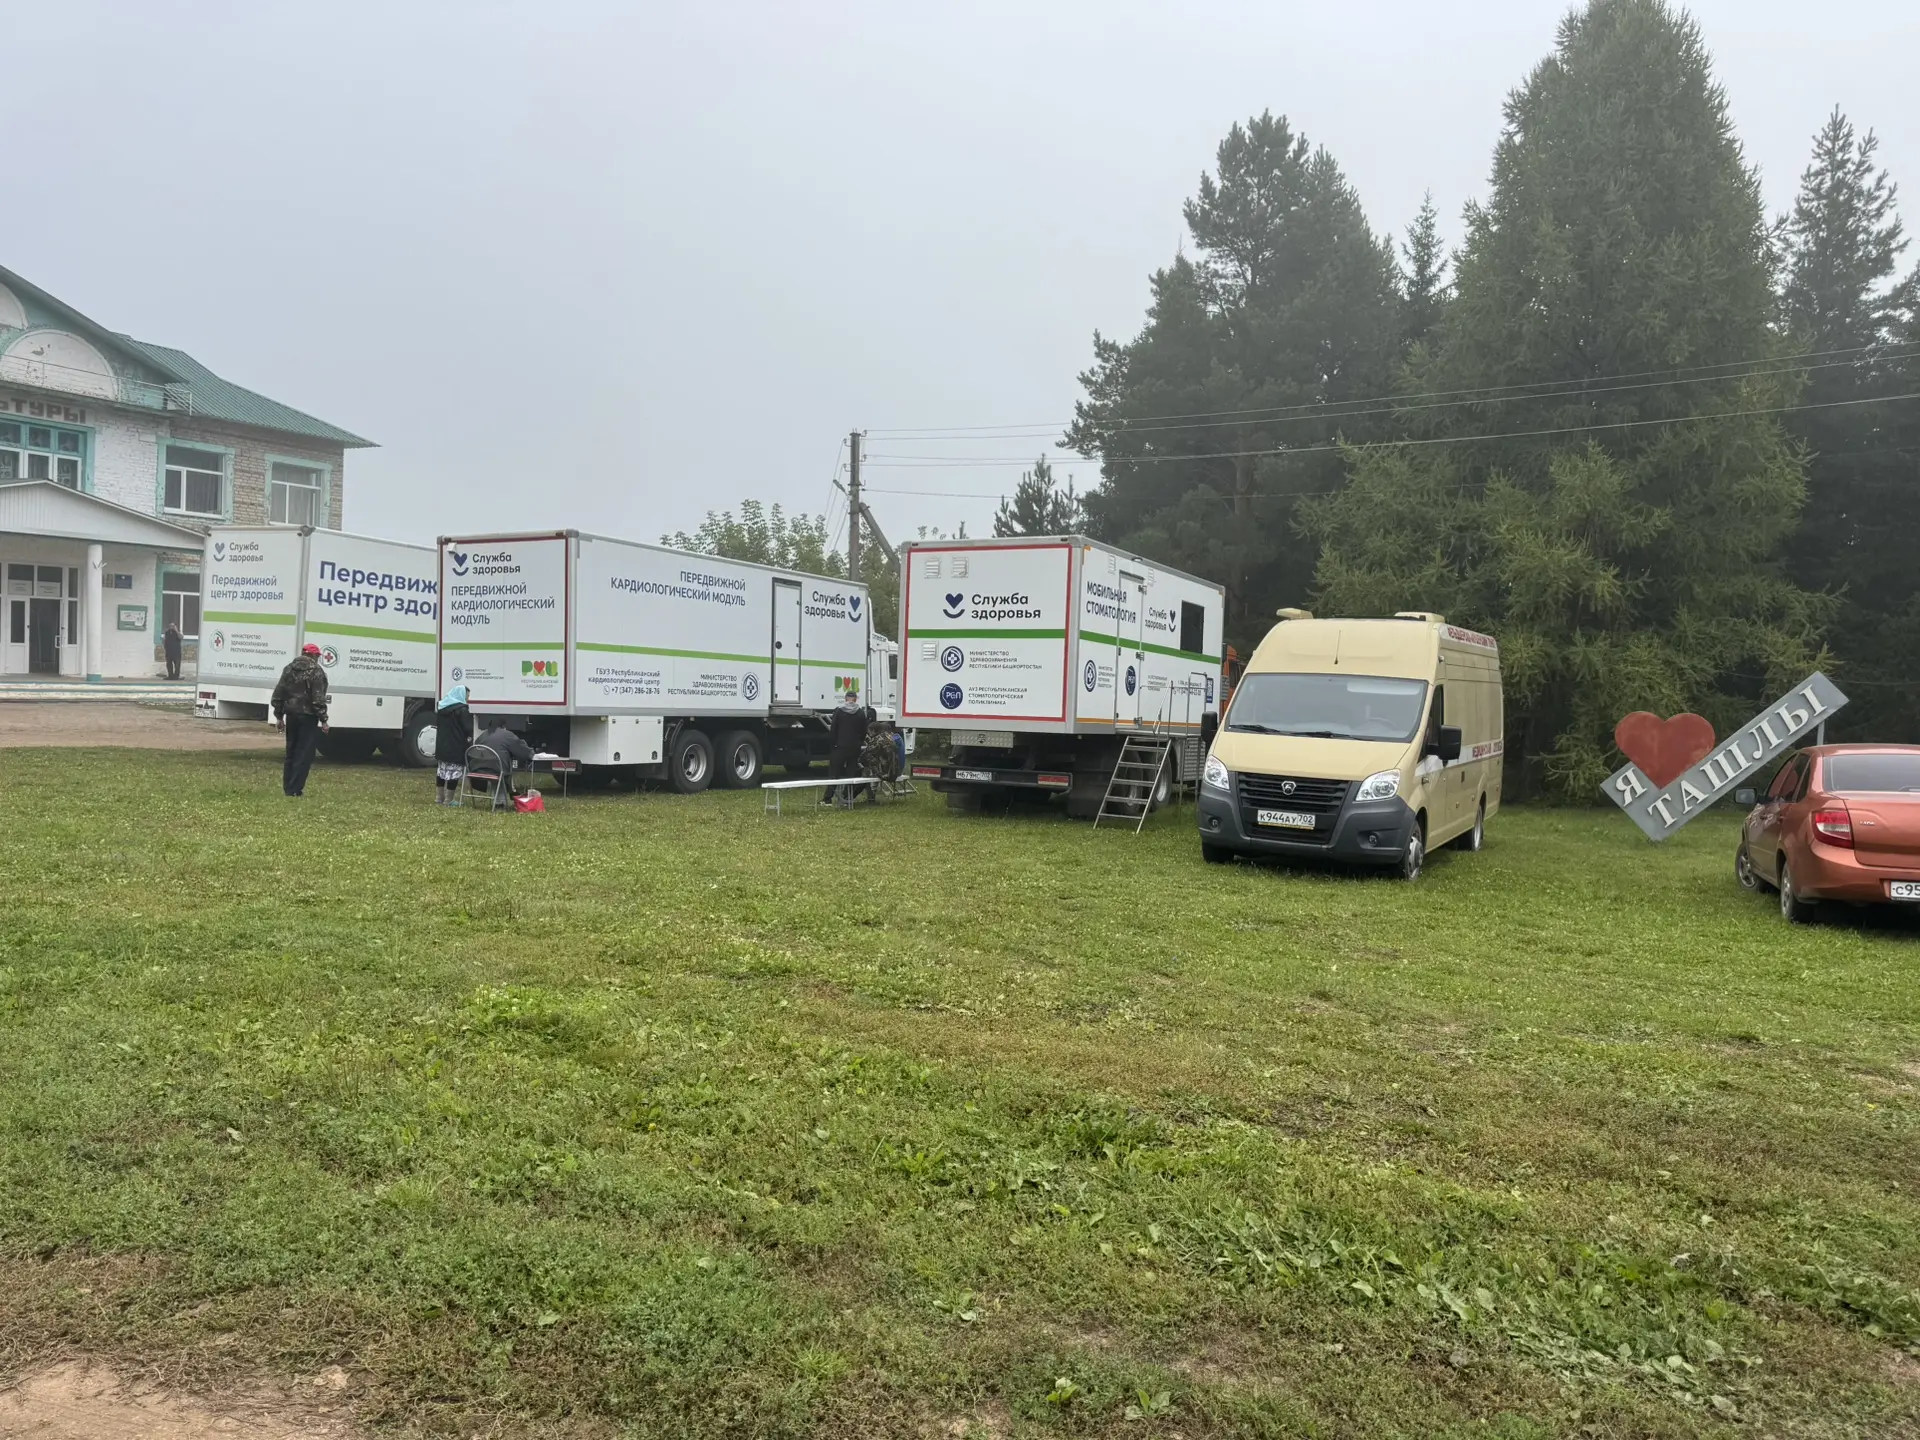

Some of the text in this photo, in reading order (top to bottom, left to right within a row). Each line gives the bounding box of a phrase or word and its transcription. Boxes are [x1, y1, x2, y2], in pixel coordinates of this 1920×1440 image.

[229, 541, 259, 553] Служба
[228, 553, 263, 563] здоровья
[472, 552, 512, 565] Служба
[472, 565, 521, 576] здоровья
[211, 574, 277, 588] Передвижной
[680, 570, 746, 591] ПЕРЕДВИЖНОЙ
[210, 590, 284, 602] центр здоровья
[451, 581, 527, 597] ПЕРЕДВИЖНОЙ
[610, 576, 746, 607] КАРДИОЛОГИЧЕСКИЙ МОДУЛЬ
[1086, 581, 1127, 604] МОБИЛЬНАЯ
[318, 587, 388, 613] центр
[451, 596, 555, 612] КАРДИОЛОГИЧЕСКИЙ
[812, 590, 846, 606] Служба
[971, 592, 1029, 607] Служба
[804, 605, 846, 620] здоровья
[971, 609, 1041, 621] здоровья
[1085, 600, 1136, 623] СТОМАТОЛОГИЯ
[1148, 607, 1167, 621] Служба
[451, 614, 490, 626] МОДУЛЬ
[1144, 619, 1167, 631] здоровья
[350, 649, 393, 657] МИНИСТЕРСТВО
[596, 667, 660, 677] ГБУЗ Республиканский
[700, 673, 737, 681] МИНИСТЕРСТВО
[692, 681, 737, 689] ЗДРАВООХРАНЕНИЯ
[700, 689, 737, 697] БАШКОРТОСТАН
[1647, 683, 1827, 829] ТАШЛЫ
[1615, 767, 1647, 807] Я
